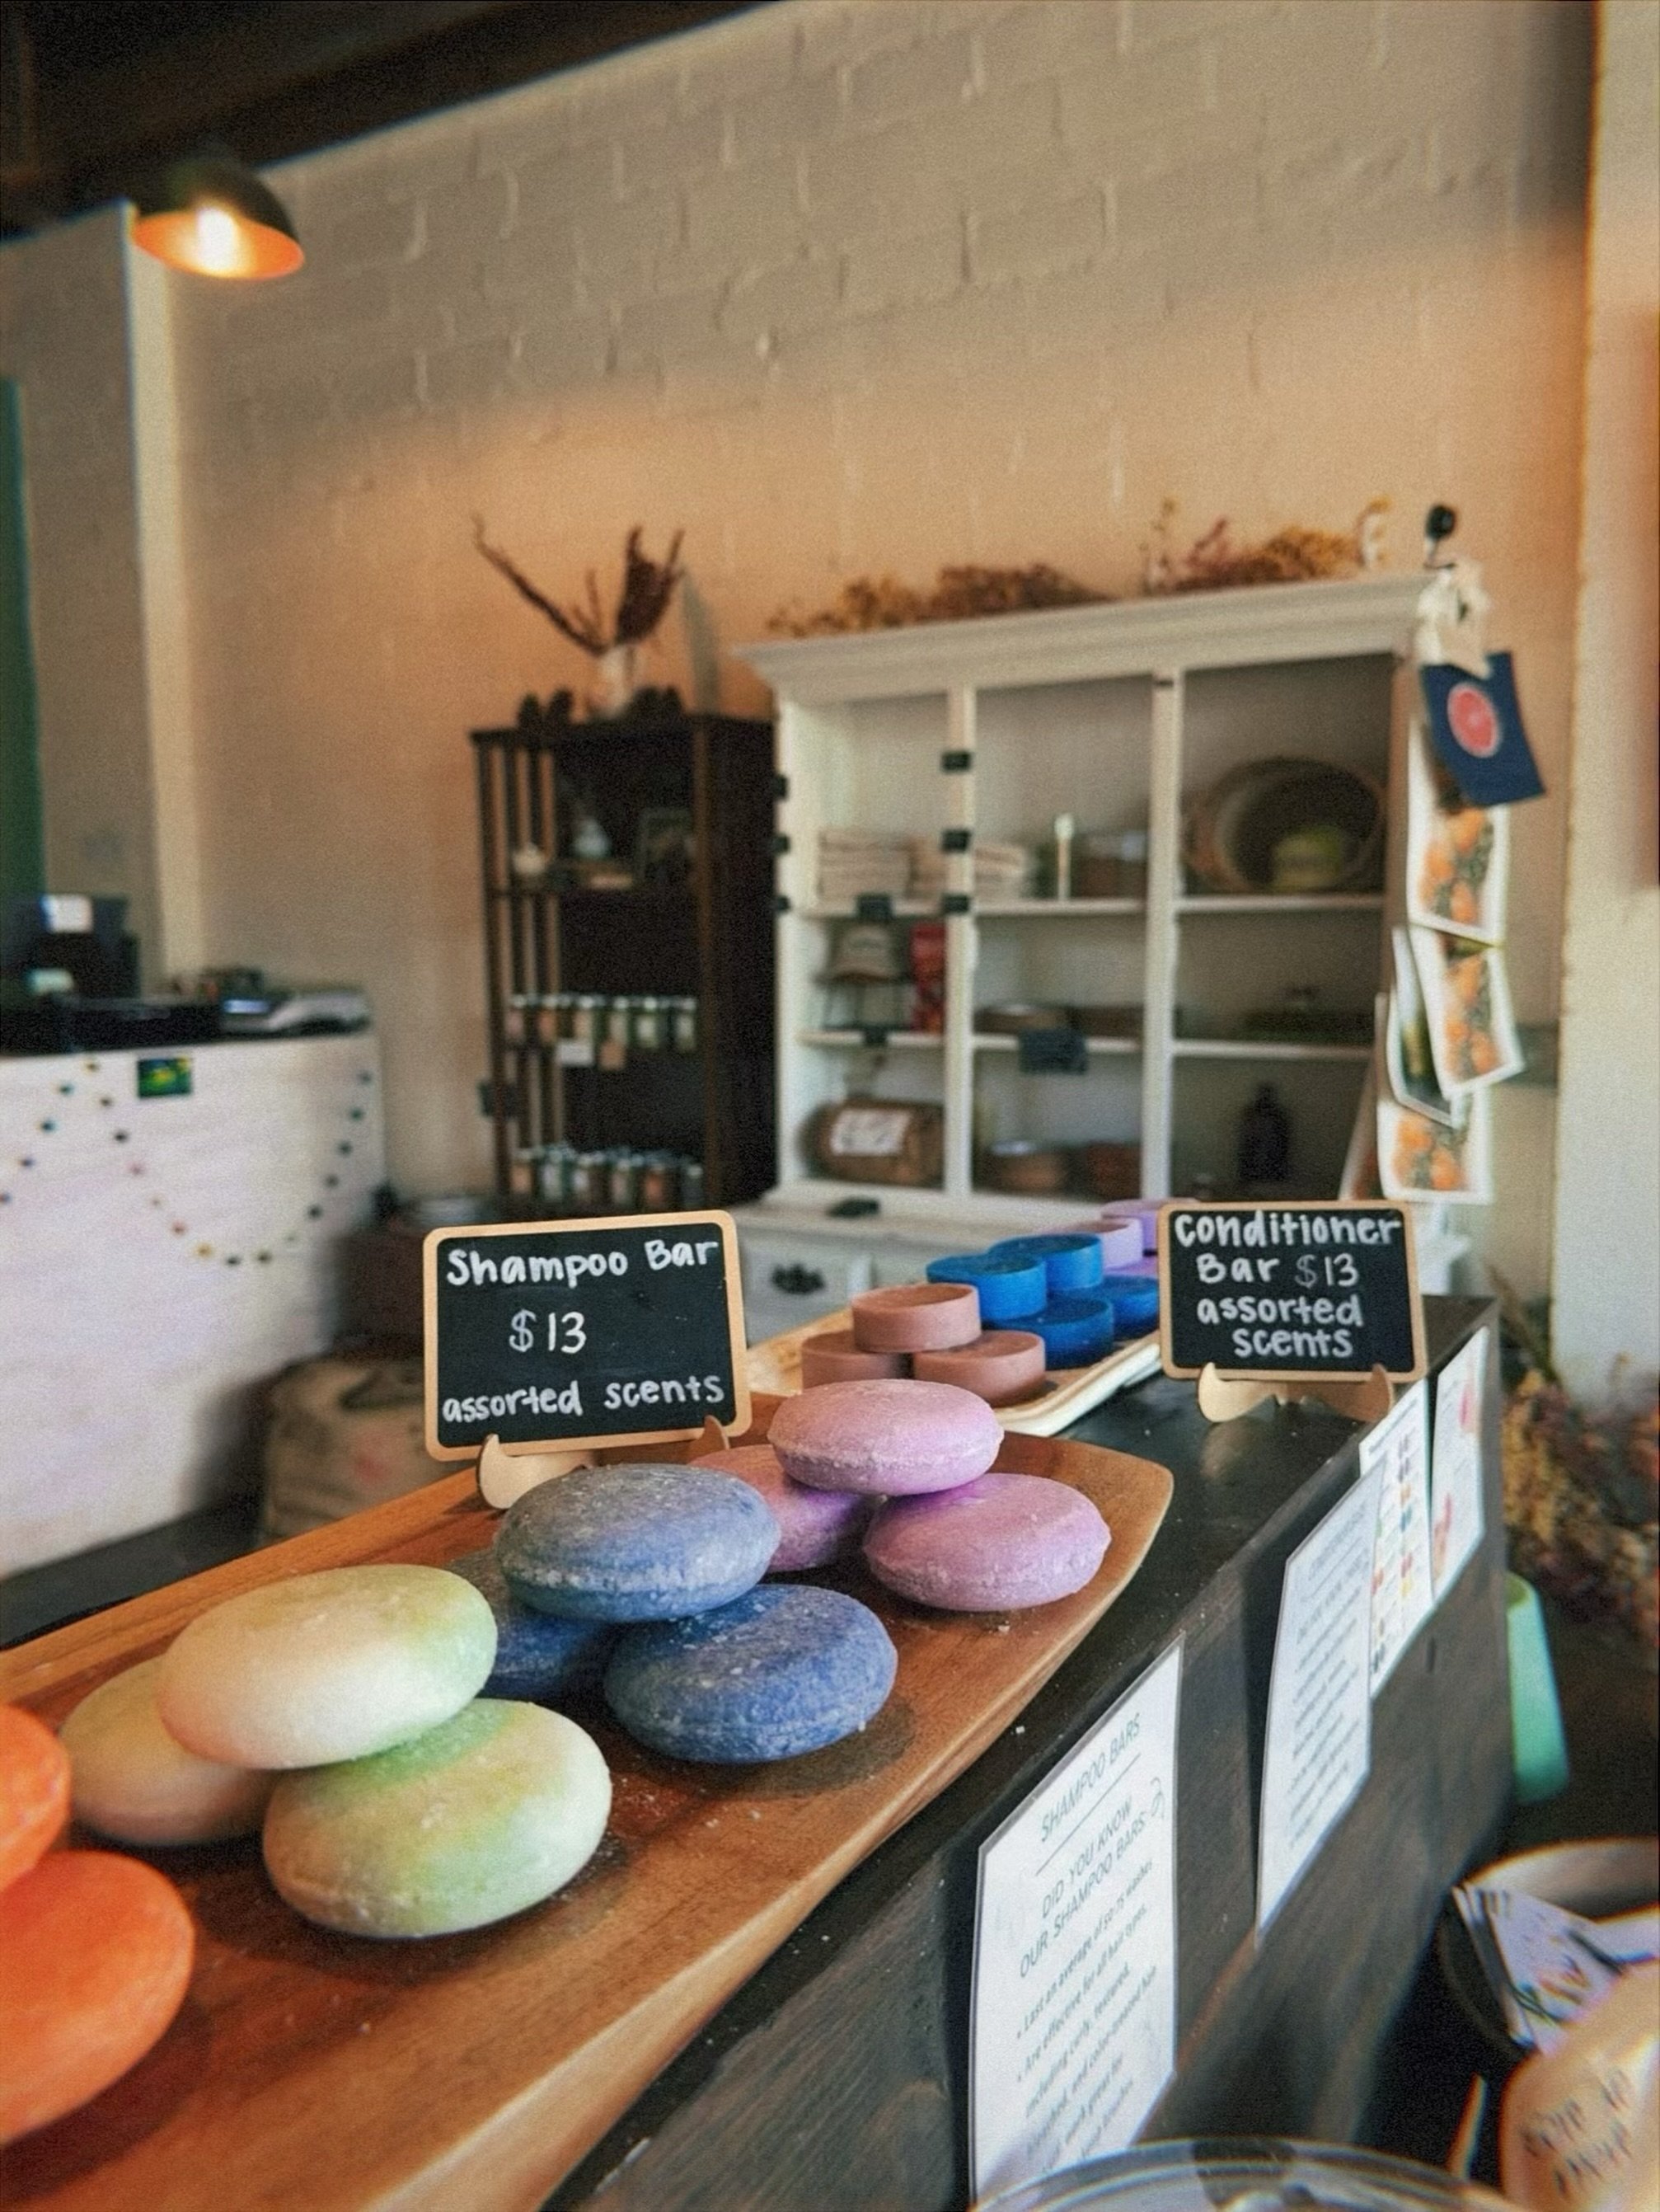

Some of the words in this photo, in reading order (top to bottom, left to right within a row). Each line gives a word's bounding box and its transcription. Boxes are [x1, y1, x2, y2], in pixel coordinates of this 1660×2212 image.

[447, 1248, 629, 1289] Shampoo
[645, 1238, 719, 1270] Bar
[1196, 1252, 1279, 1284] Bar
[1295, 1252, 1359, 1288] $13
[509, 1308, 587, 1354] $13
[1197, 1294, 1364, 1327] assorted
[1231, 1327, 1353, 1357] scents
[442, 1380, 584, 1423] assorted
[603, 1375, 725, 1410] scents
[1041, 1753, 1105, 1843] SHAMPOO
[1110, 1713, 1140, 1765] BARS
[1043, 1880, 1063, 1918] DID
[1069, 1843, 1094, 1884] YOU
[1098, 1796, 1131, 1851] KNOW
[1020, 1931, 1048, 1978] OUR
[1053, 1853, 1112, 1937] SHAMPOO
[1025, 1998, 1043, 2031] Last
[1046, 1982, 1057, 2003] an
[1059, 1937, 1091, 1986] average
